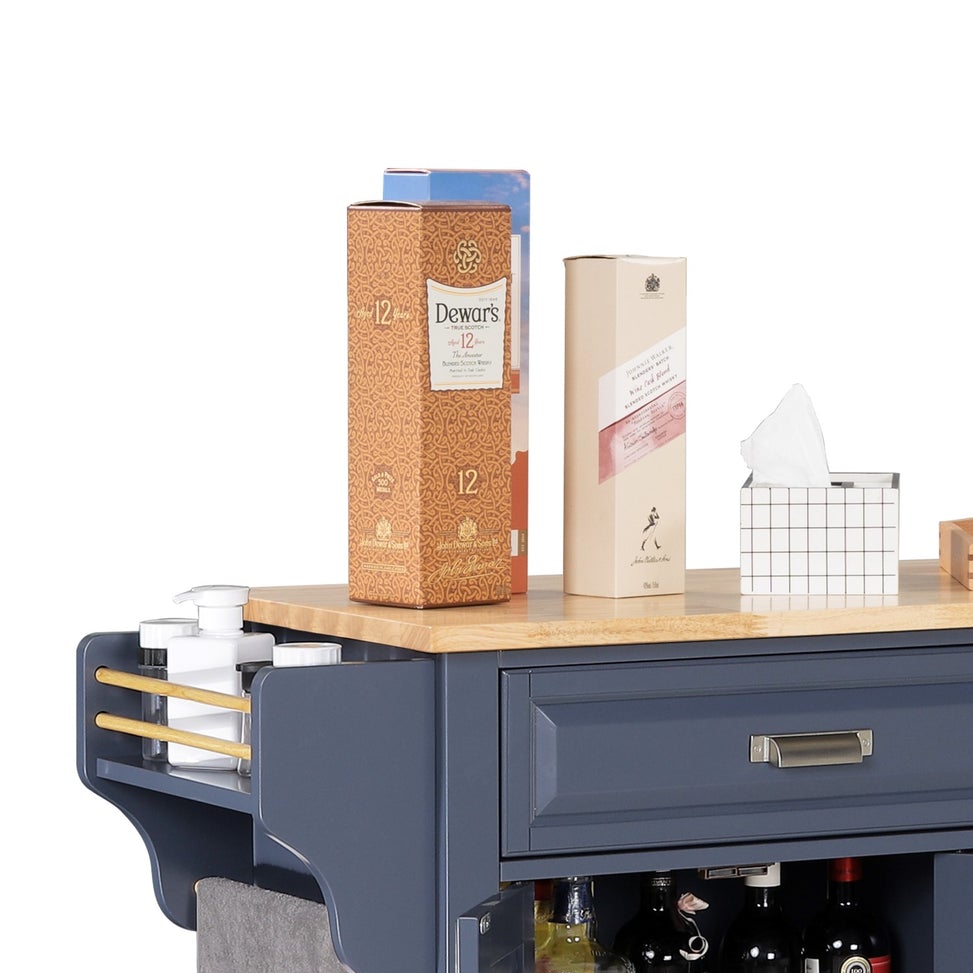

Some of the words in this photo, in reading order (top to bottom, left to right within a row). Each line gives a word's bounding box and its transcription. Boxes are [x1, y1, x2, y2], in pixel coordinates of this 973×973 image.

[375, 300, 391, 325] 12
[435, 303, 499, 324] Dewar's
[461, 332, 474, 349] 12
[458, 469, 478, 495] 12
